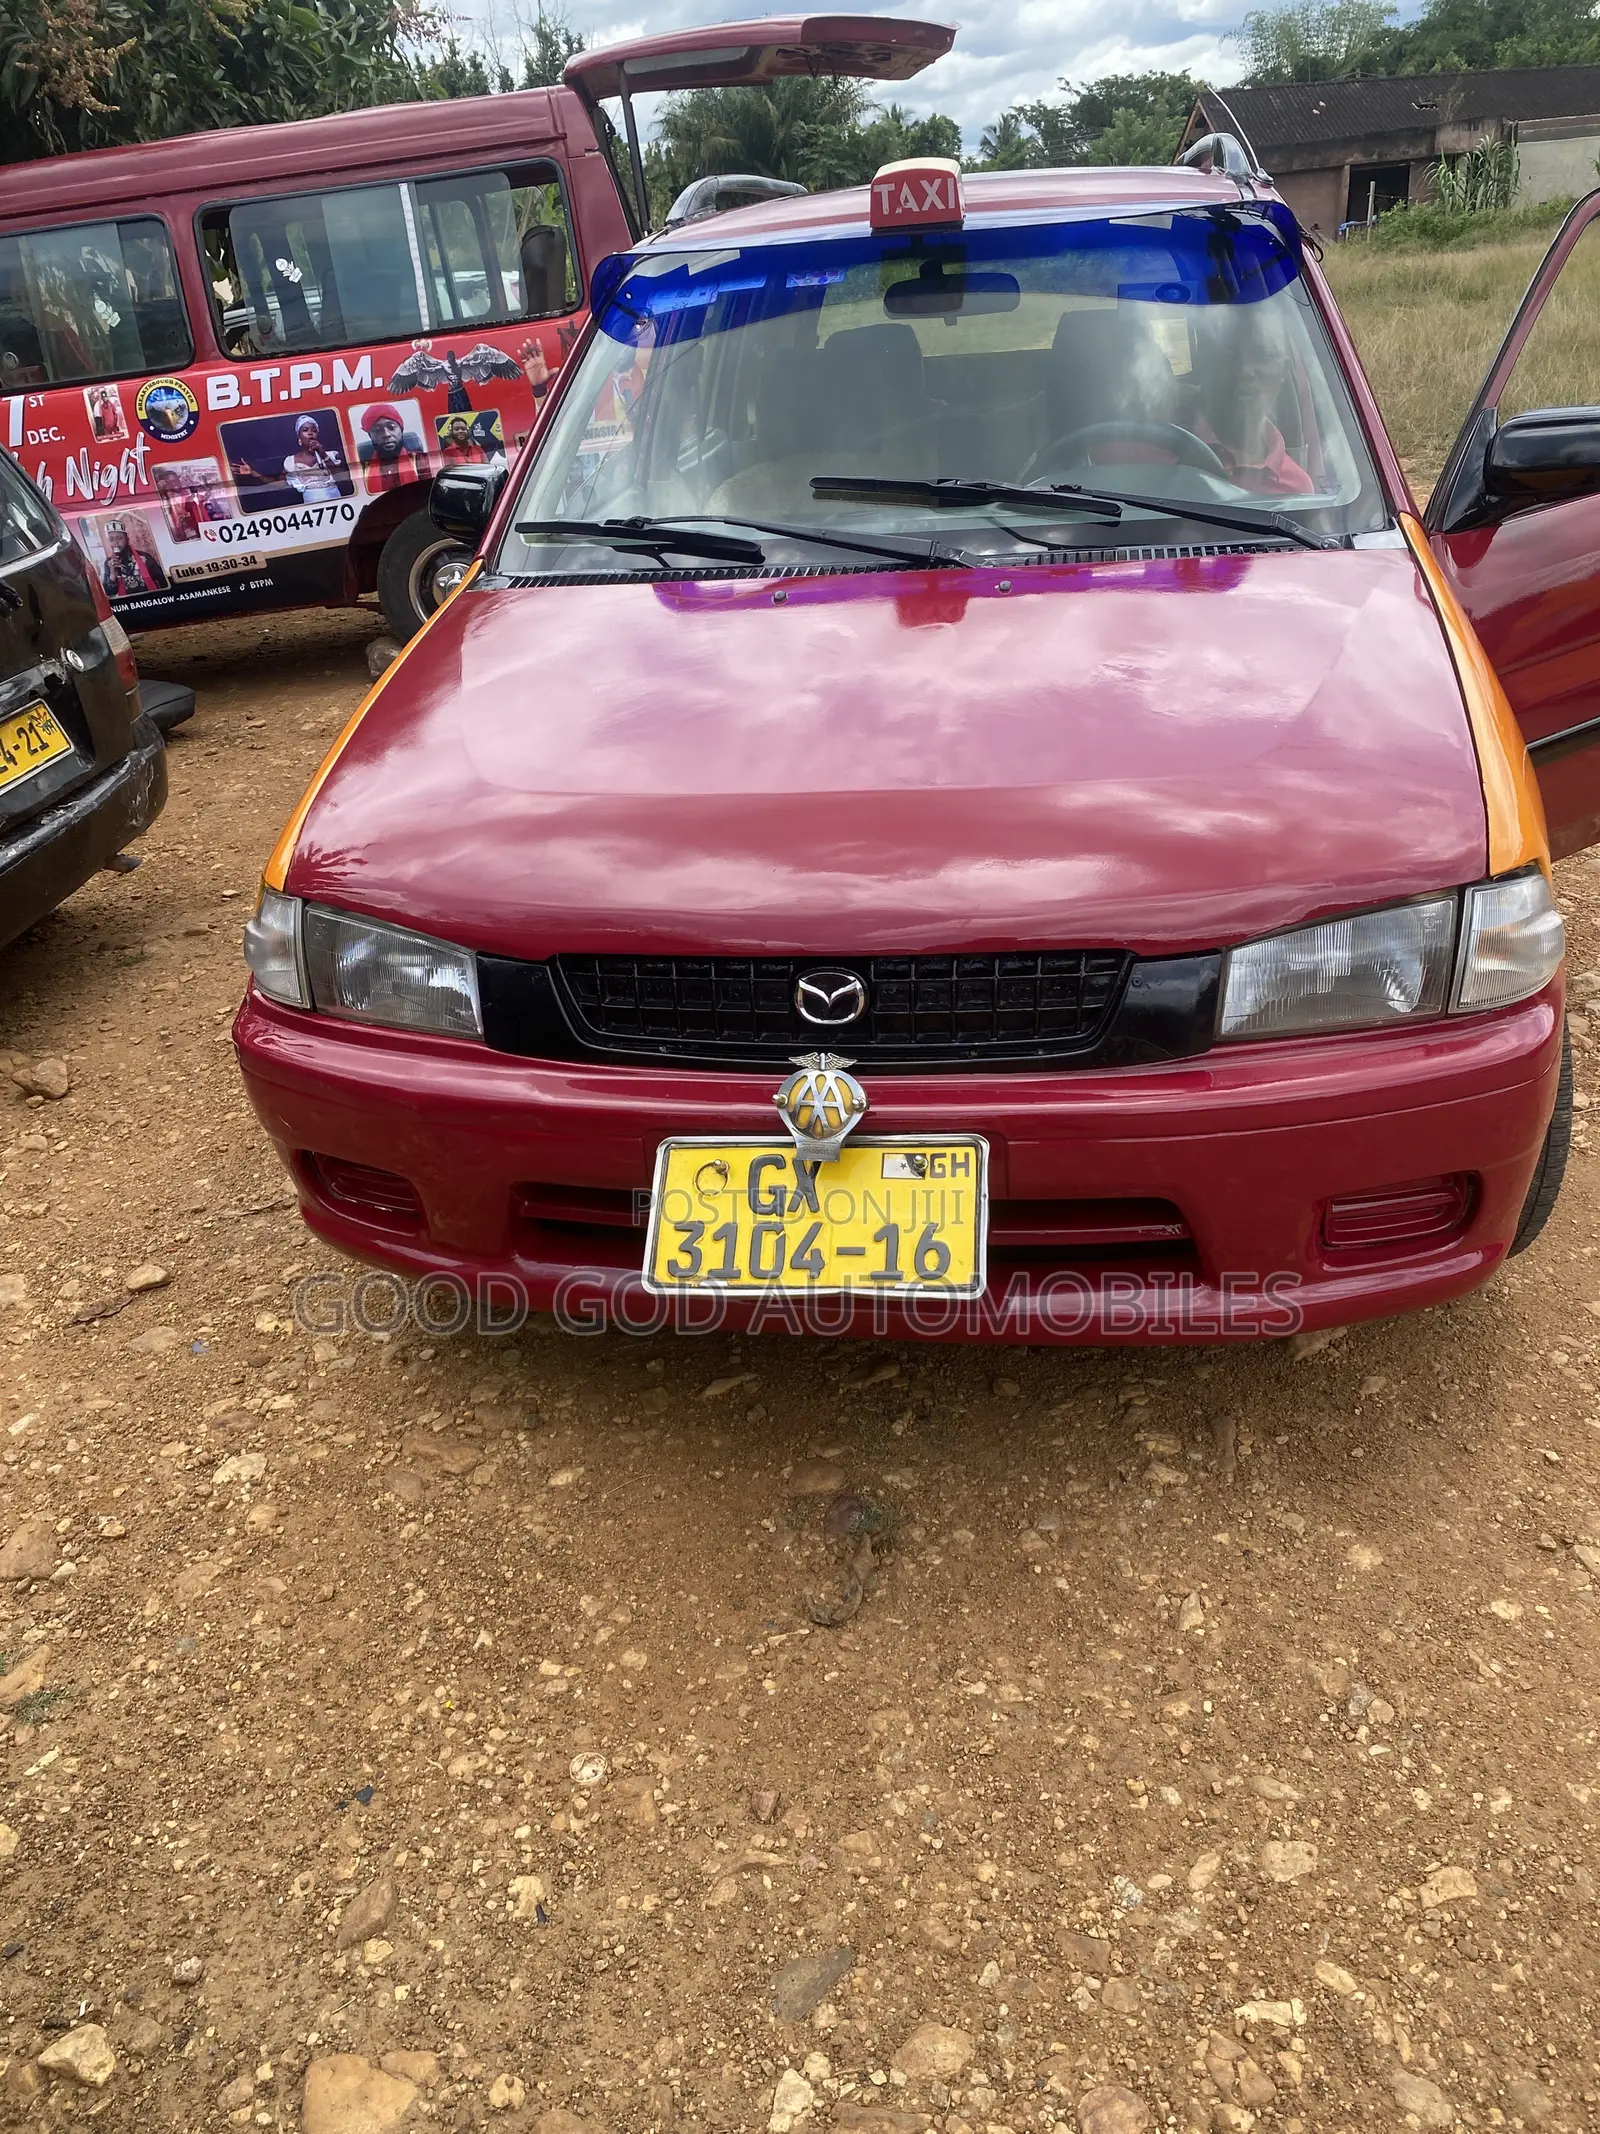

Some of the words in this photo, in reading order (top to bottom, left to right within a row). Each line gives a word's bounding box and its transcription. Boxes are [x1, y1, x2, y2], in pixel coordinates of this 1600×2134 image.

[873, 177, 956, 215] TAXI
[206, 355, 384, 411] B.T.P.M.
[26, 426, 66, 445] DEC.
[160, 429, 188, 440] MINISTRY
[66, 431, 151, 506] Night
[218, 503, 355, 543] 0249044770
[175, 566, 205, 579] Luke
[205, 555, 258, 574] 19:30-34
[250, 578, 274, 589] BTPM
[129, 596, 175, 610] BANGALOW
[748, 1154, 820, 1217] GX
[930, 1152, 970, 1179] GH
[667, 1221, 951, 1281] 3104-16
